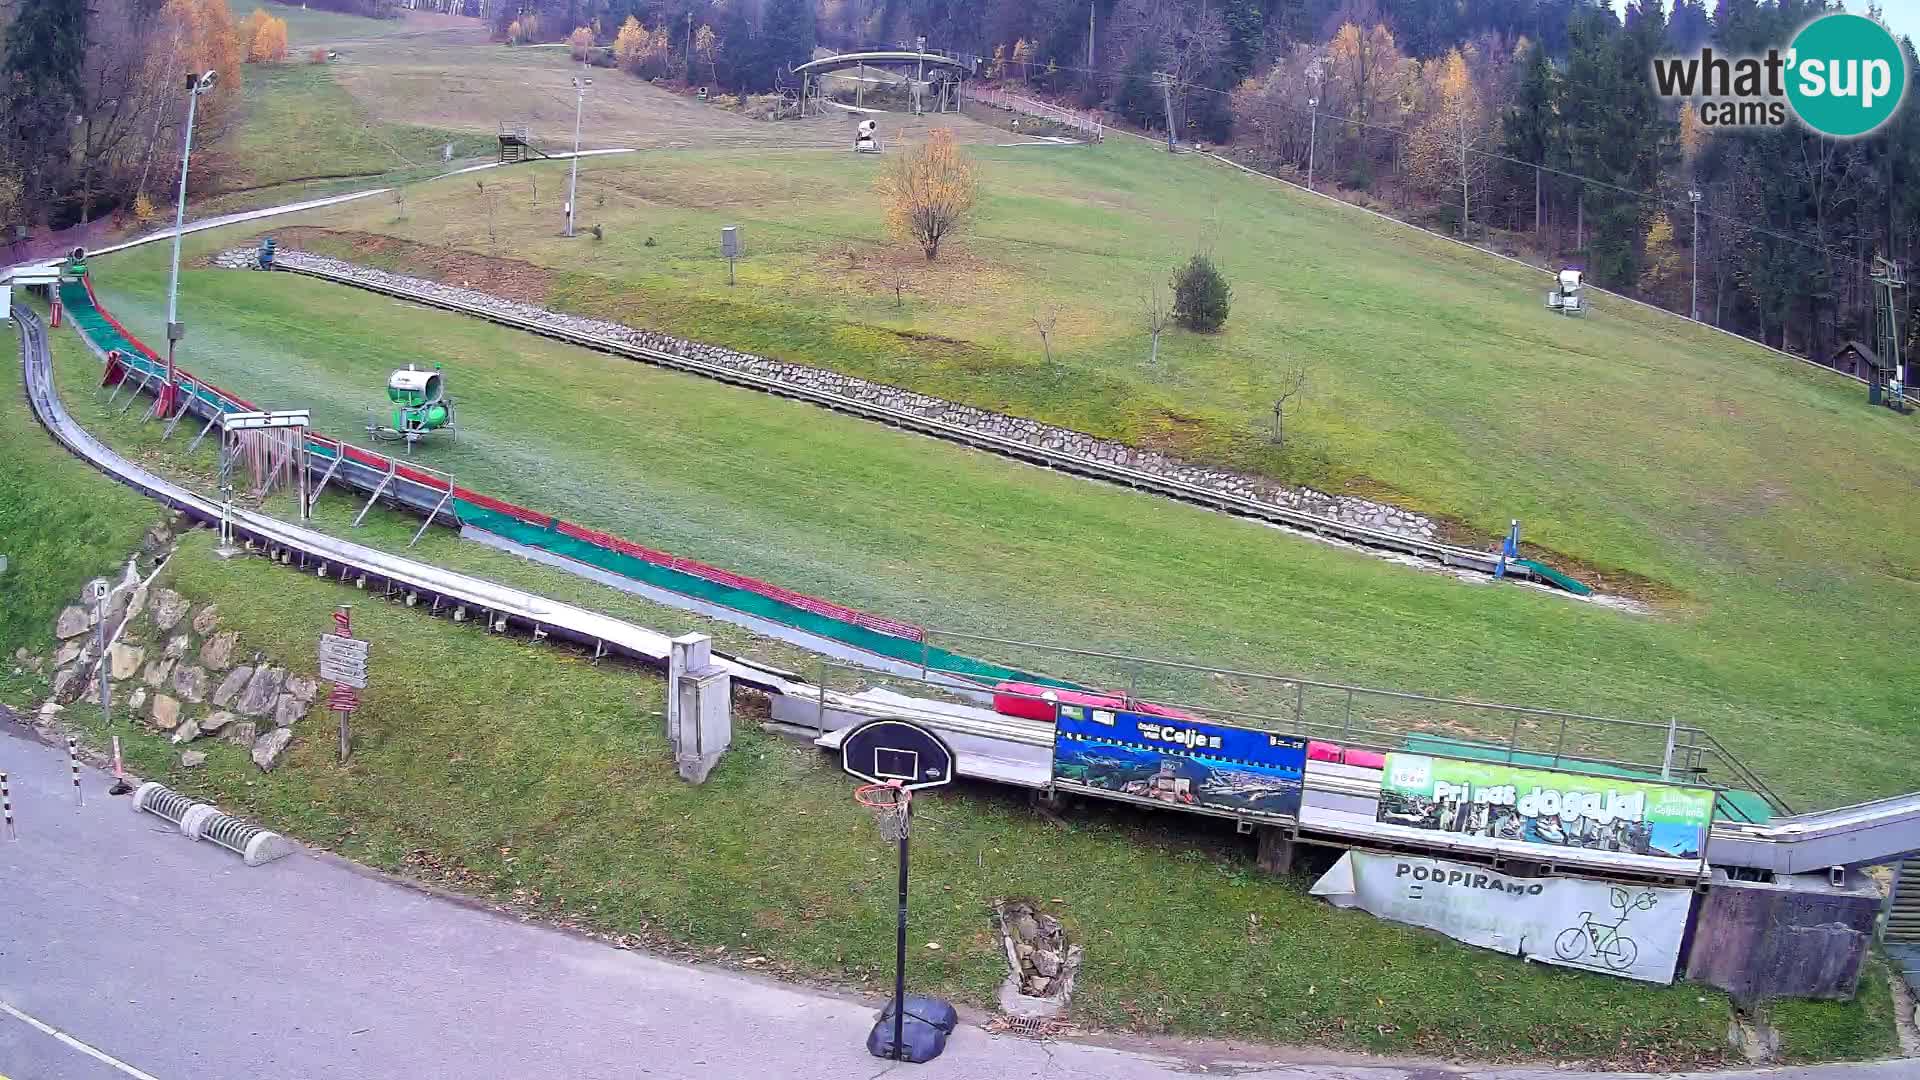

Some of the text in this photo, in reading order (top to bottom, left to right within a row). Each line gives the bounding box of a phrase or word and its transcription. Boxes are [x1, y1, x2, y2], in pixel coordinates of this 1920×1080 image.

[1161, 727, 1207, 748] Celje
[1433, 780, 1470, 803] Pri
[1395, 862, 1544, 896] PODPIRAMO
